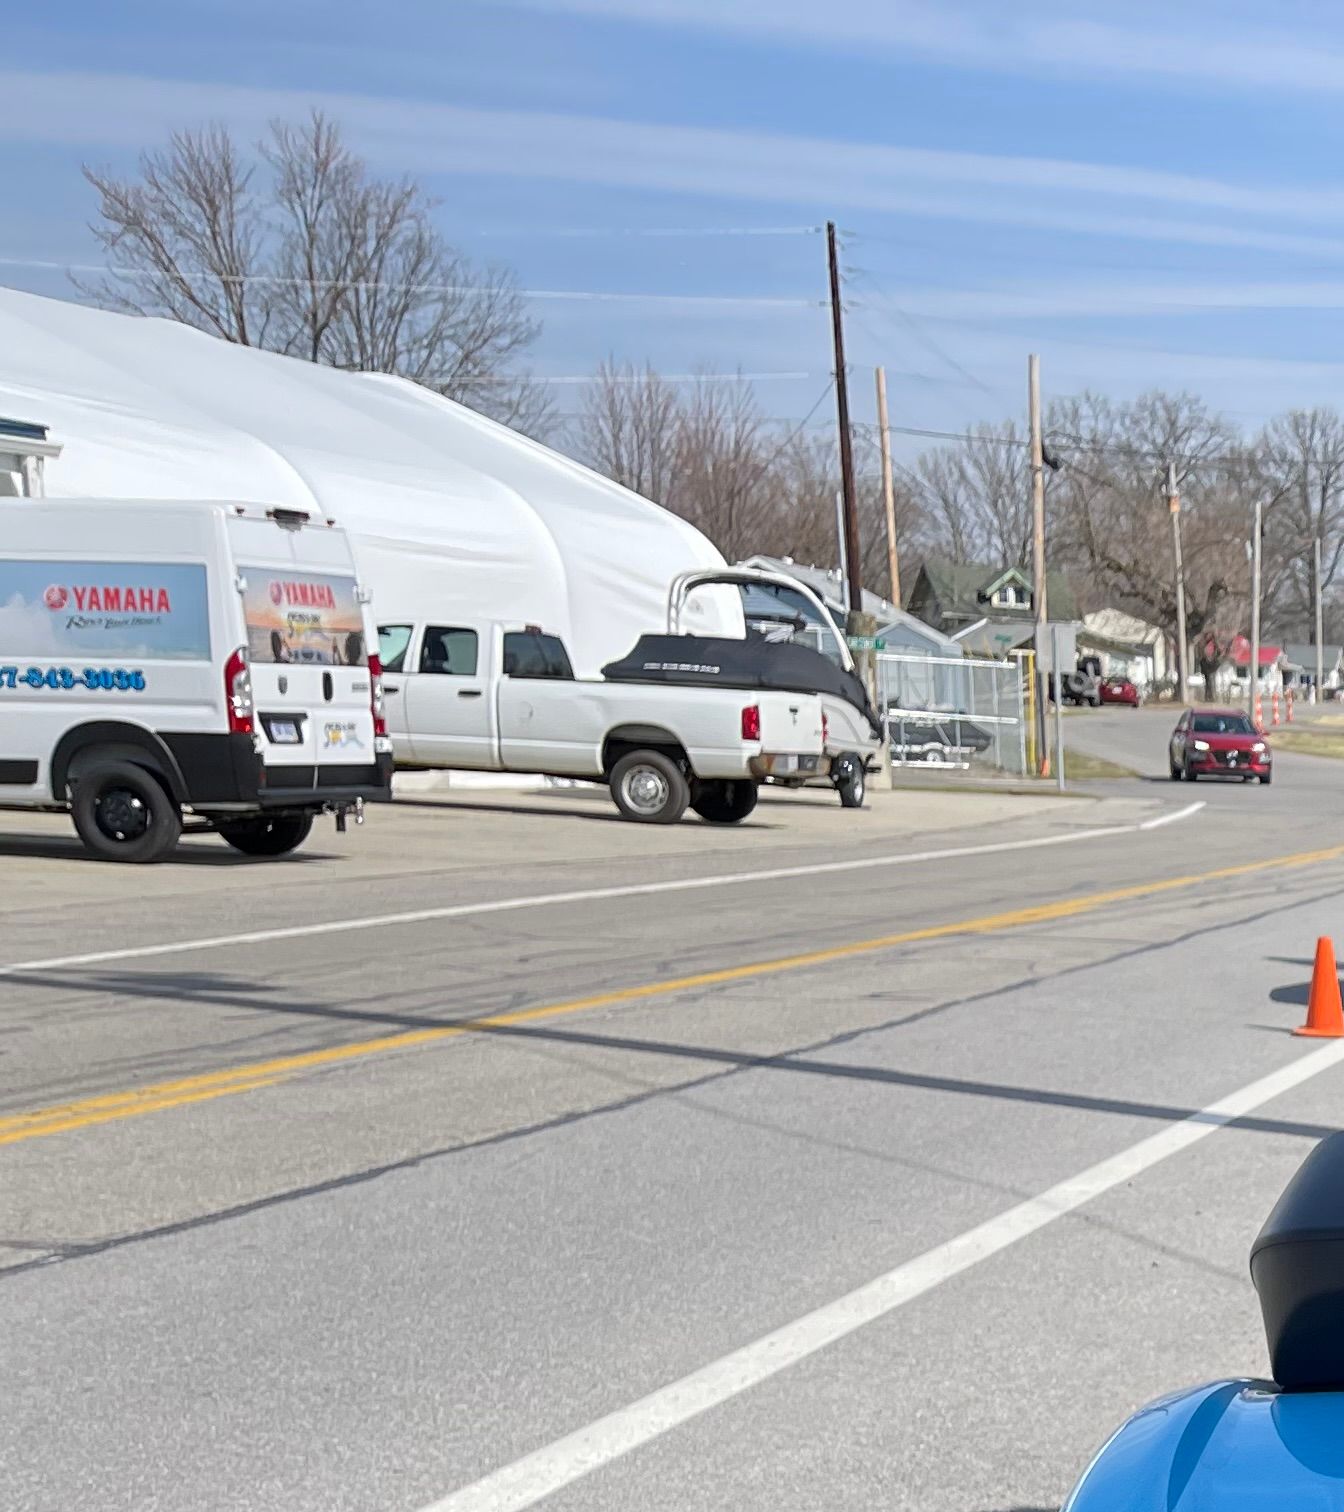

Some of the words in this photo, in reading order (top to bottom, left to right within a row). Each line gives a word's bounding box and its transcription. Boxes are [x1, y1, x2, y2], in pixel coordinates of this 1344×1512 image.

[72, 586, 171, 612] YAMAHA
[282, 581, 336, 609] YAMAHA
[0, 666, 146, 690] 7-843-3036
